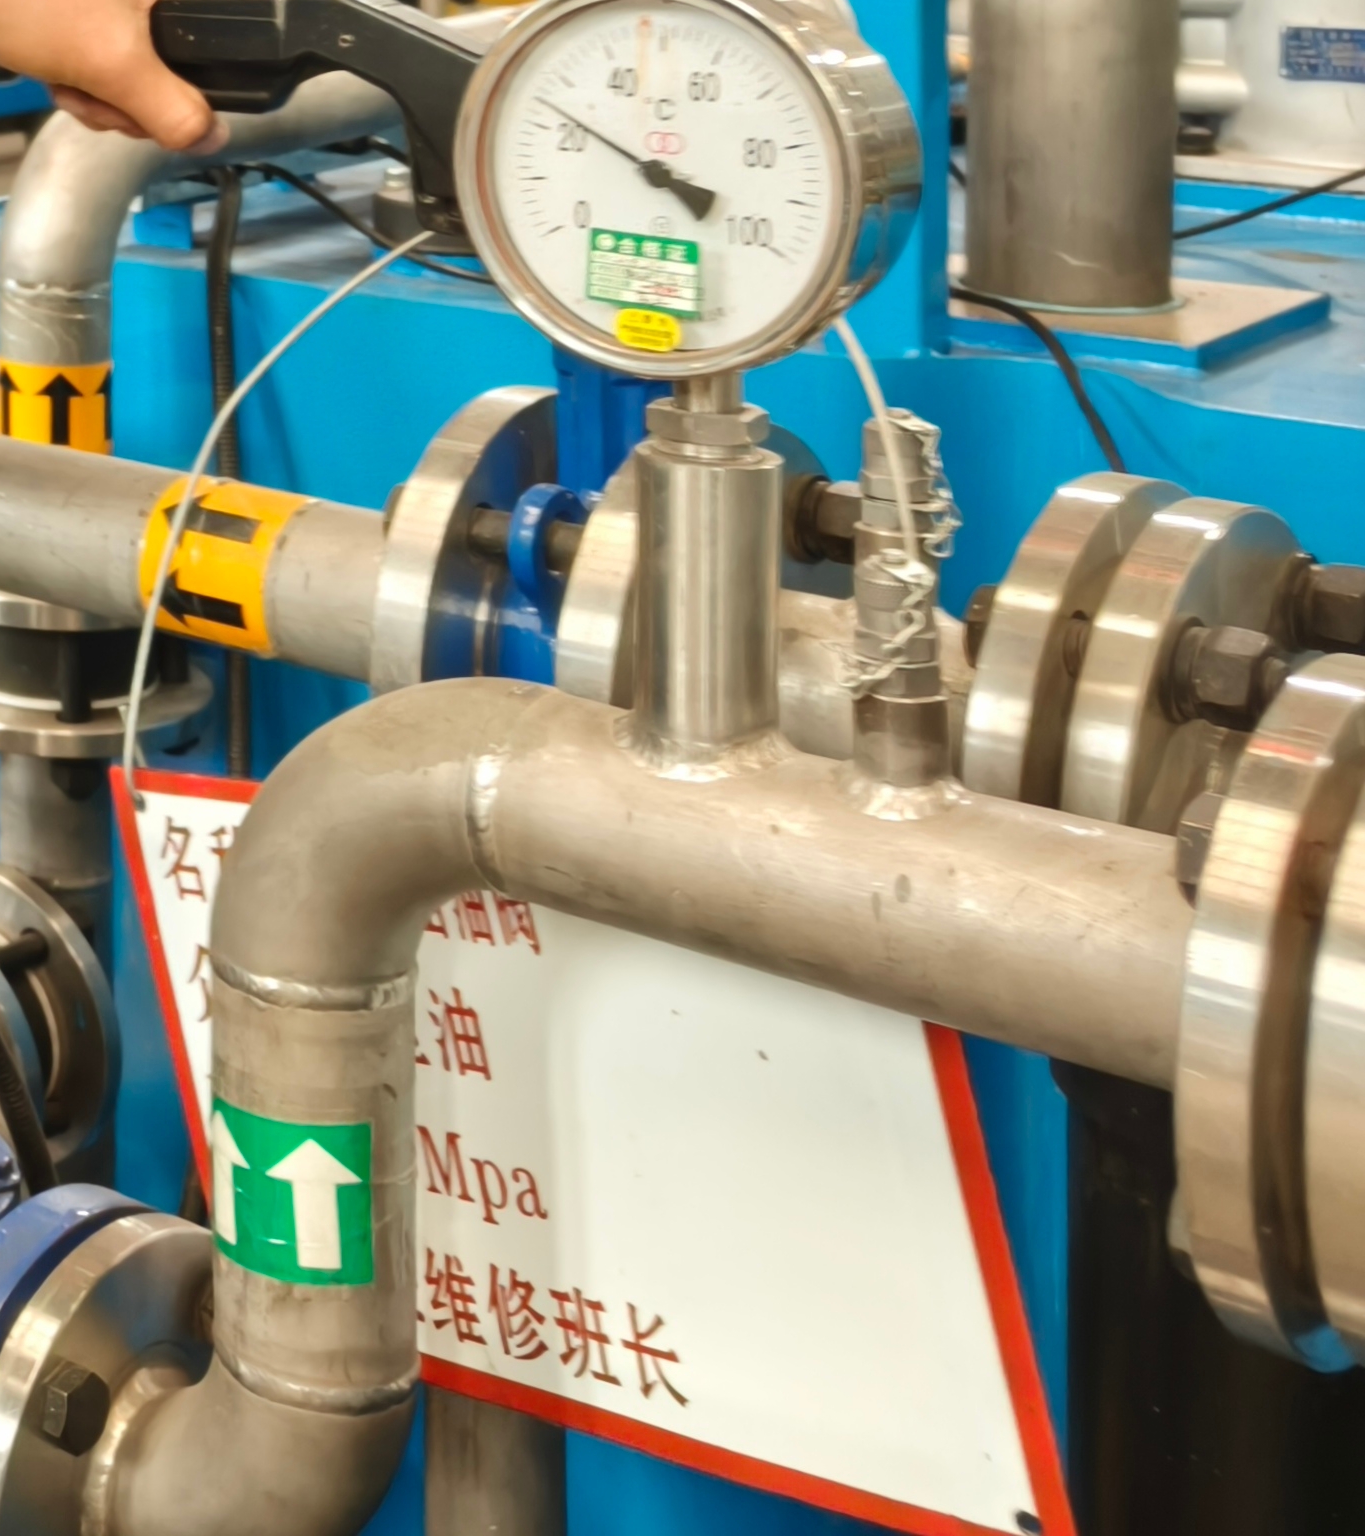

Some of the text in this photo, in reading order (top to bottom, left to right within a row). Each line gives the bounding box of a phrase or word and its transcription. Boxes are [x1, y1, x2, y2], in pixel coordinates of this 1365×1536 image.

[607, 67, 637, 97] 40
[688, 72, 721, 102] 60
[557, 122, 588, 152] 20
[743, 138, 777, 169] 80
[573, 201, 592, 229] 0
[725, 216, 773, 247] 100
[415, 986, 492, 1082] 油
[416, 1125, 549, 1225] Mpa
[416, 1247, 690, 1408] 维修班长
